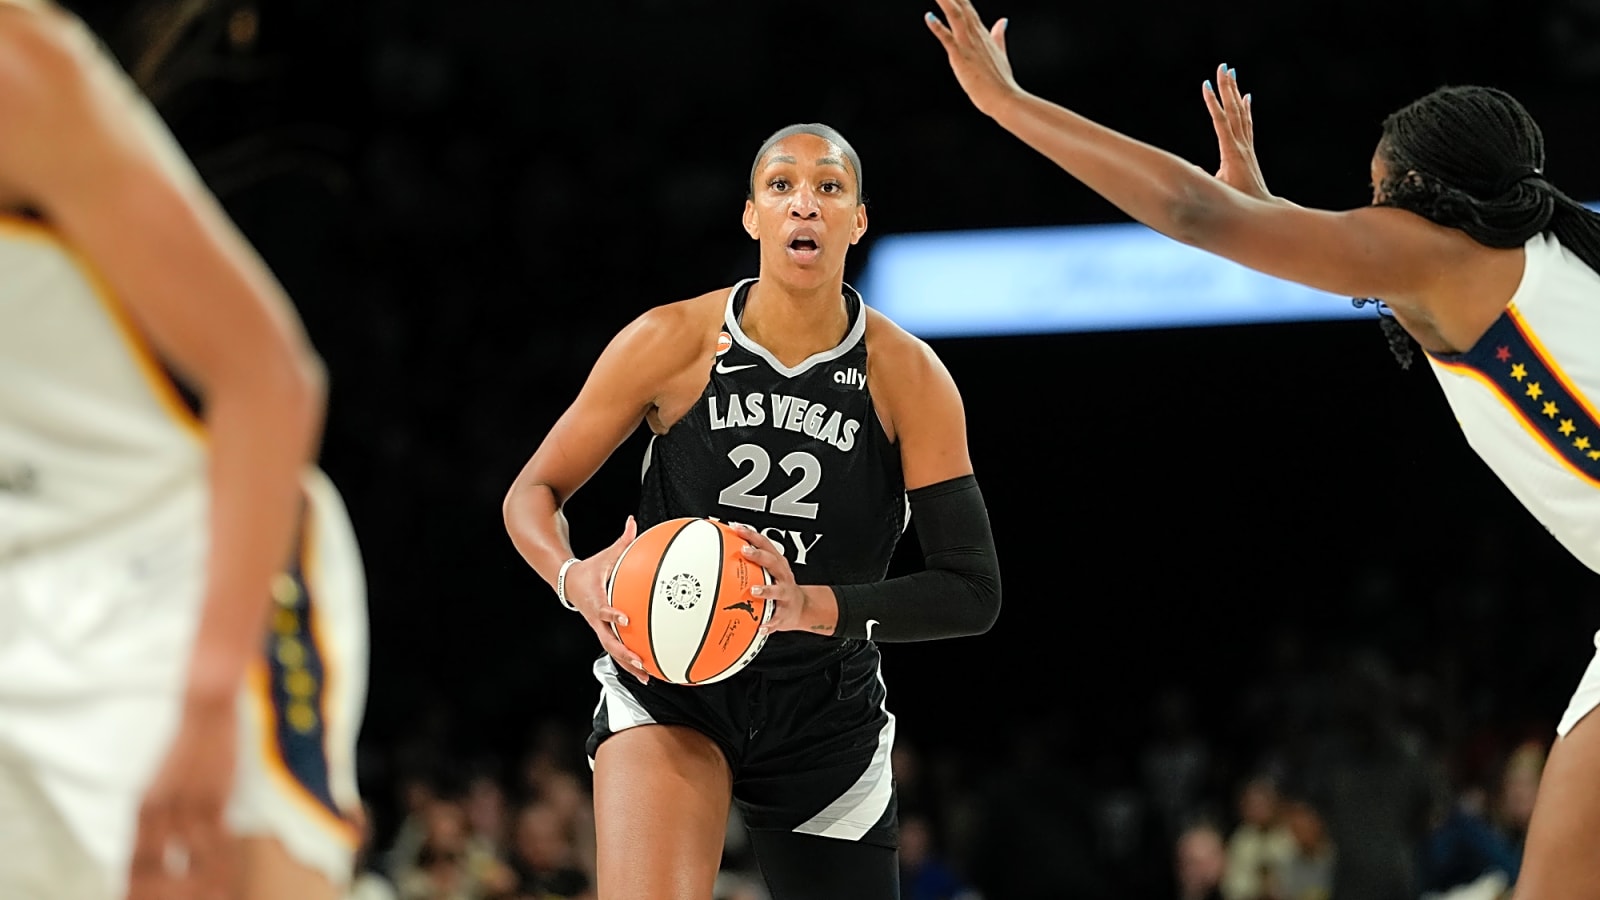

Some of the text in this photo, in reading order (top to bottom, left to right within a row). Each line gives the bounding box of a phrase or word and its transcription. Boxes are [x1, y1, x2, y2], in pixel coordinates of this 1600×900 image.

[833, 367, 867, 390] ally
[708, 392, 861, 452] LAS VEGAS
[718, 443, 822, 520] 22
[708, 515, 823, 565] SY
